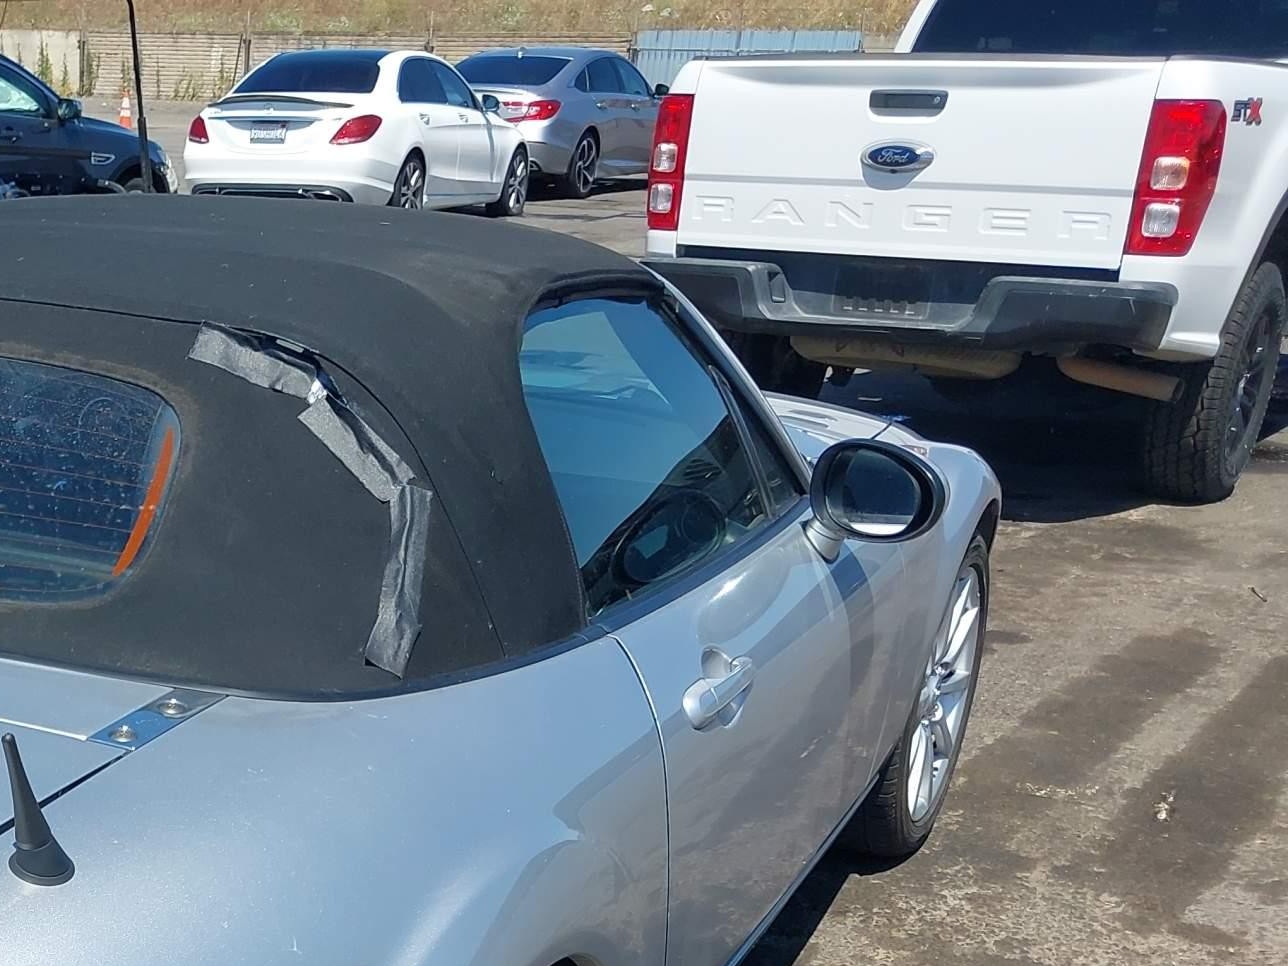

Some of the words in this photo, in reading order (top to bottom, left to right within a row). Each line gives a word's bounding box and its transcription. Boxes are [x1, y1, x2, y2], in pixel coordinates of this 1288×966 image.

[1230, 96, 1263, 127] STX
[877, 147, 911, 164] Ford
[690, 194, 1113, 242] RANGER
